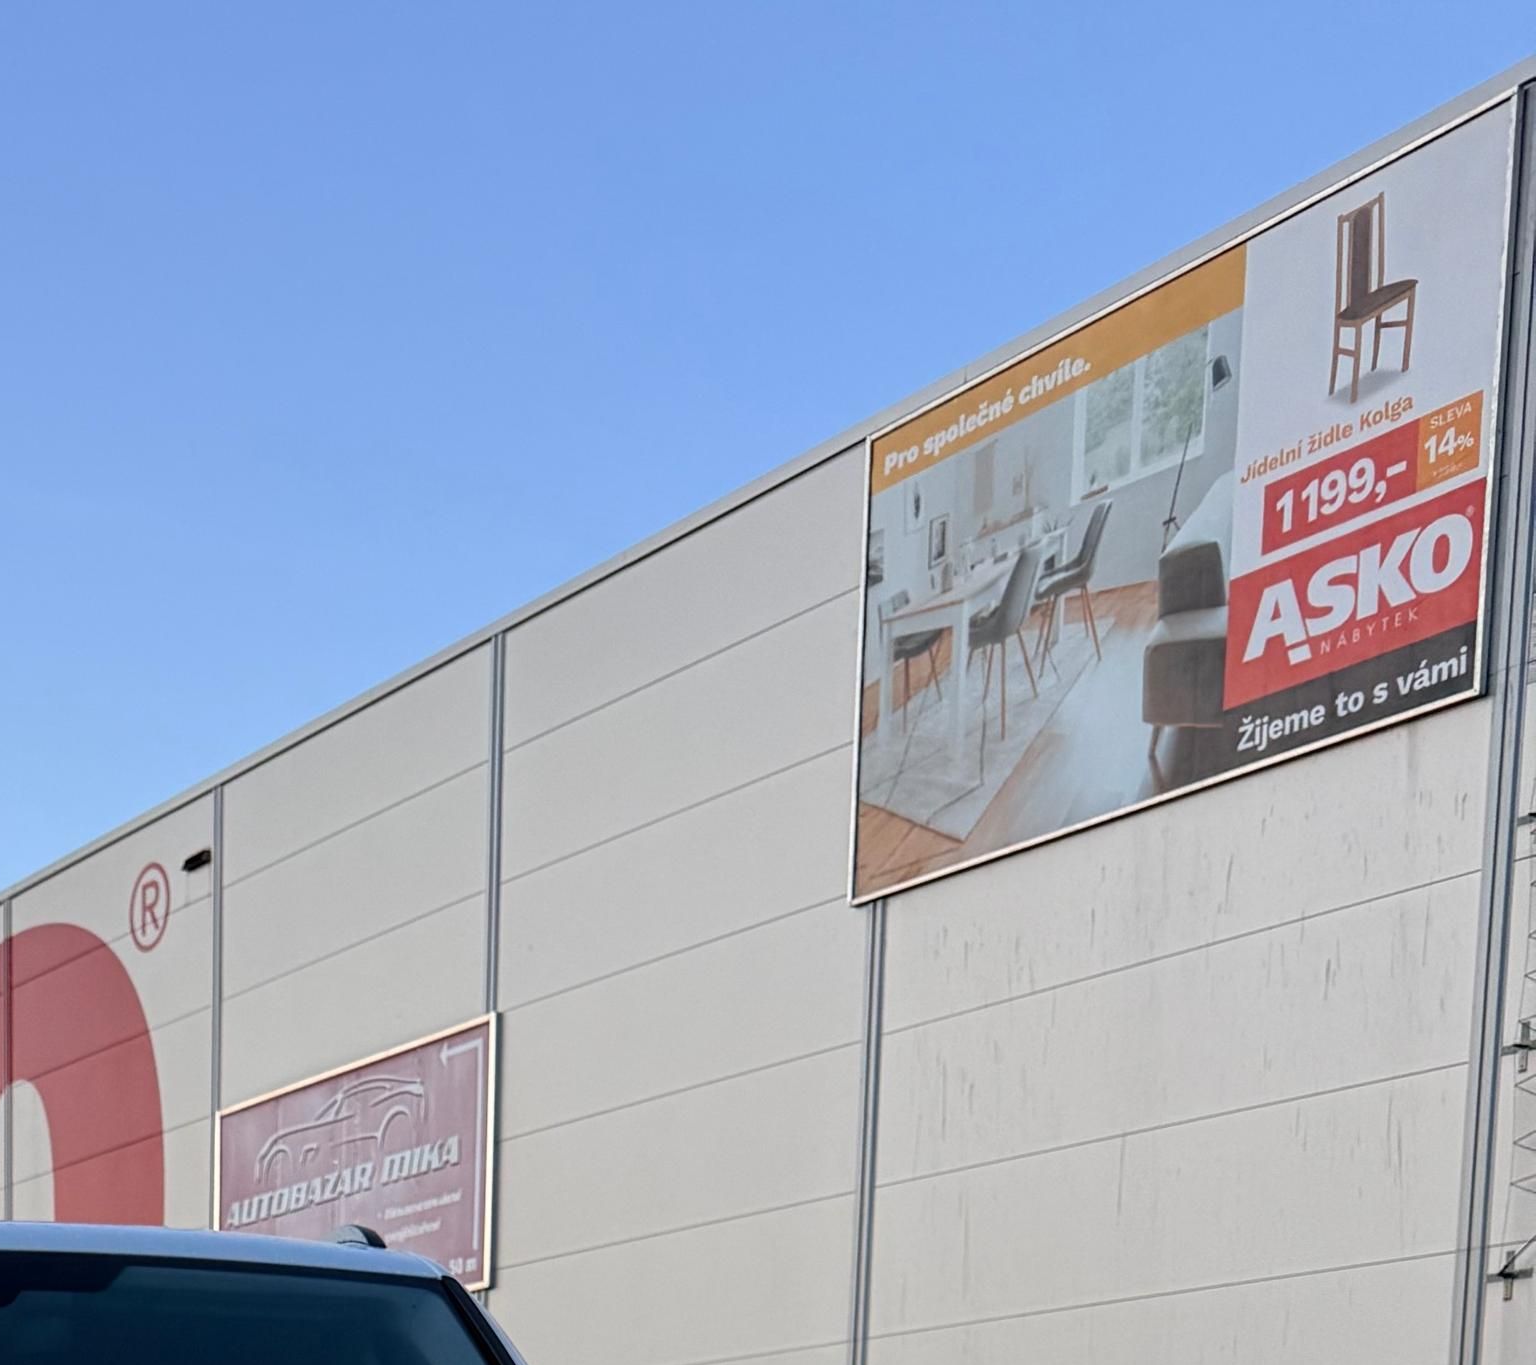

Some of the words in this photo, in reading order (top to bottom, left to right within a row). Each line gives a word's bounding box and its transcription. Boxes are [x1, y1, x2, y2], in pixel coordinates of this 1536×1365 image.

[883, 446, 919, 475] Pro
[923, 388, 1015, 457] společné
[1019, 357, 1092, 404] chvíle.
[1240, 439, 1302, 484] Jídelní
[1308, 424, 1353, 455] židle
[1360, 396, 1413, 432] Kolga
[1424, 426, 1474, 464] 14%
[1430, 401, 1472, 430] SLEVA
[1241, 513, 1473, 666] ASKO
[1236, 704, 1325, 752] Žijeme
[1335, 690, 1365, 717] to
[1372, 682, 1389, 705] s
[1396, 645, 1468, 695] vámi
[226, 1161, 373, 1229] AUTOBAZAR
[382, 1135, 460, 1186] MIKA
